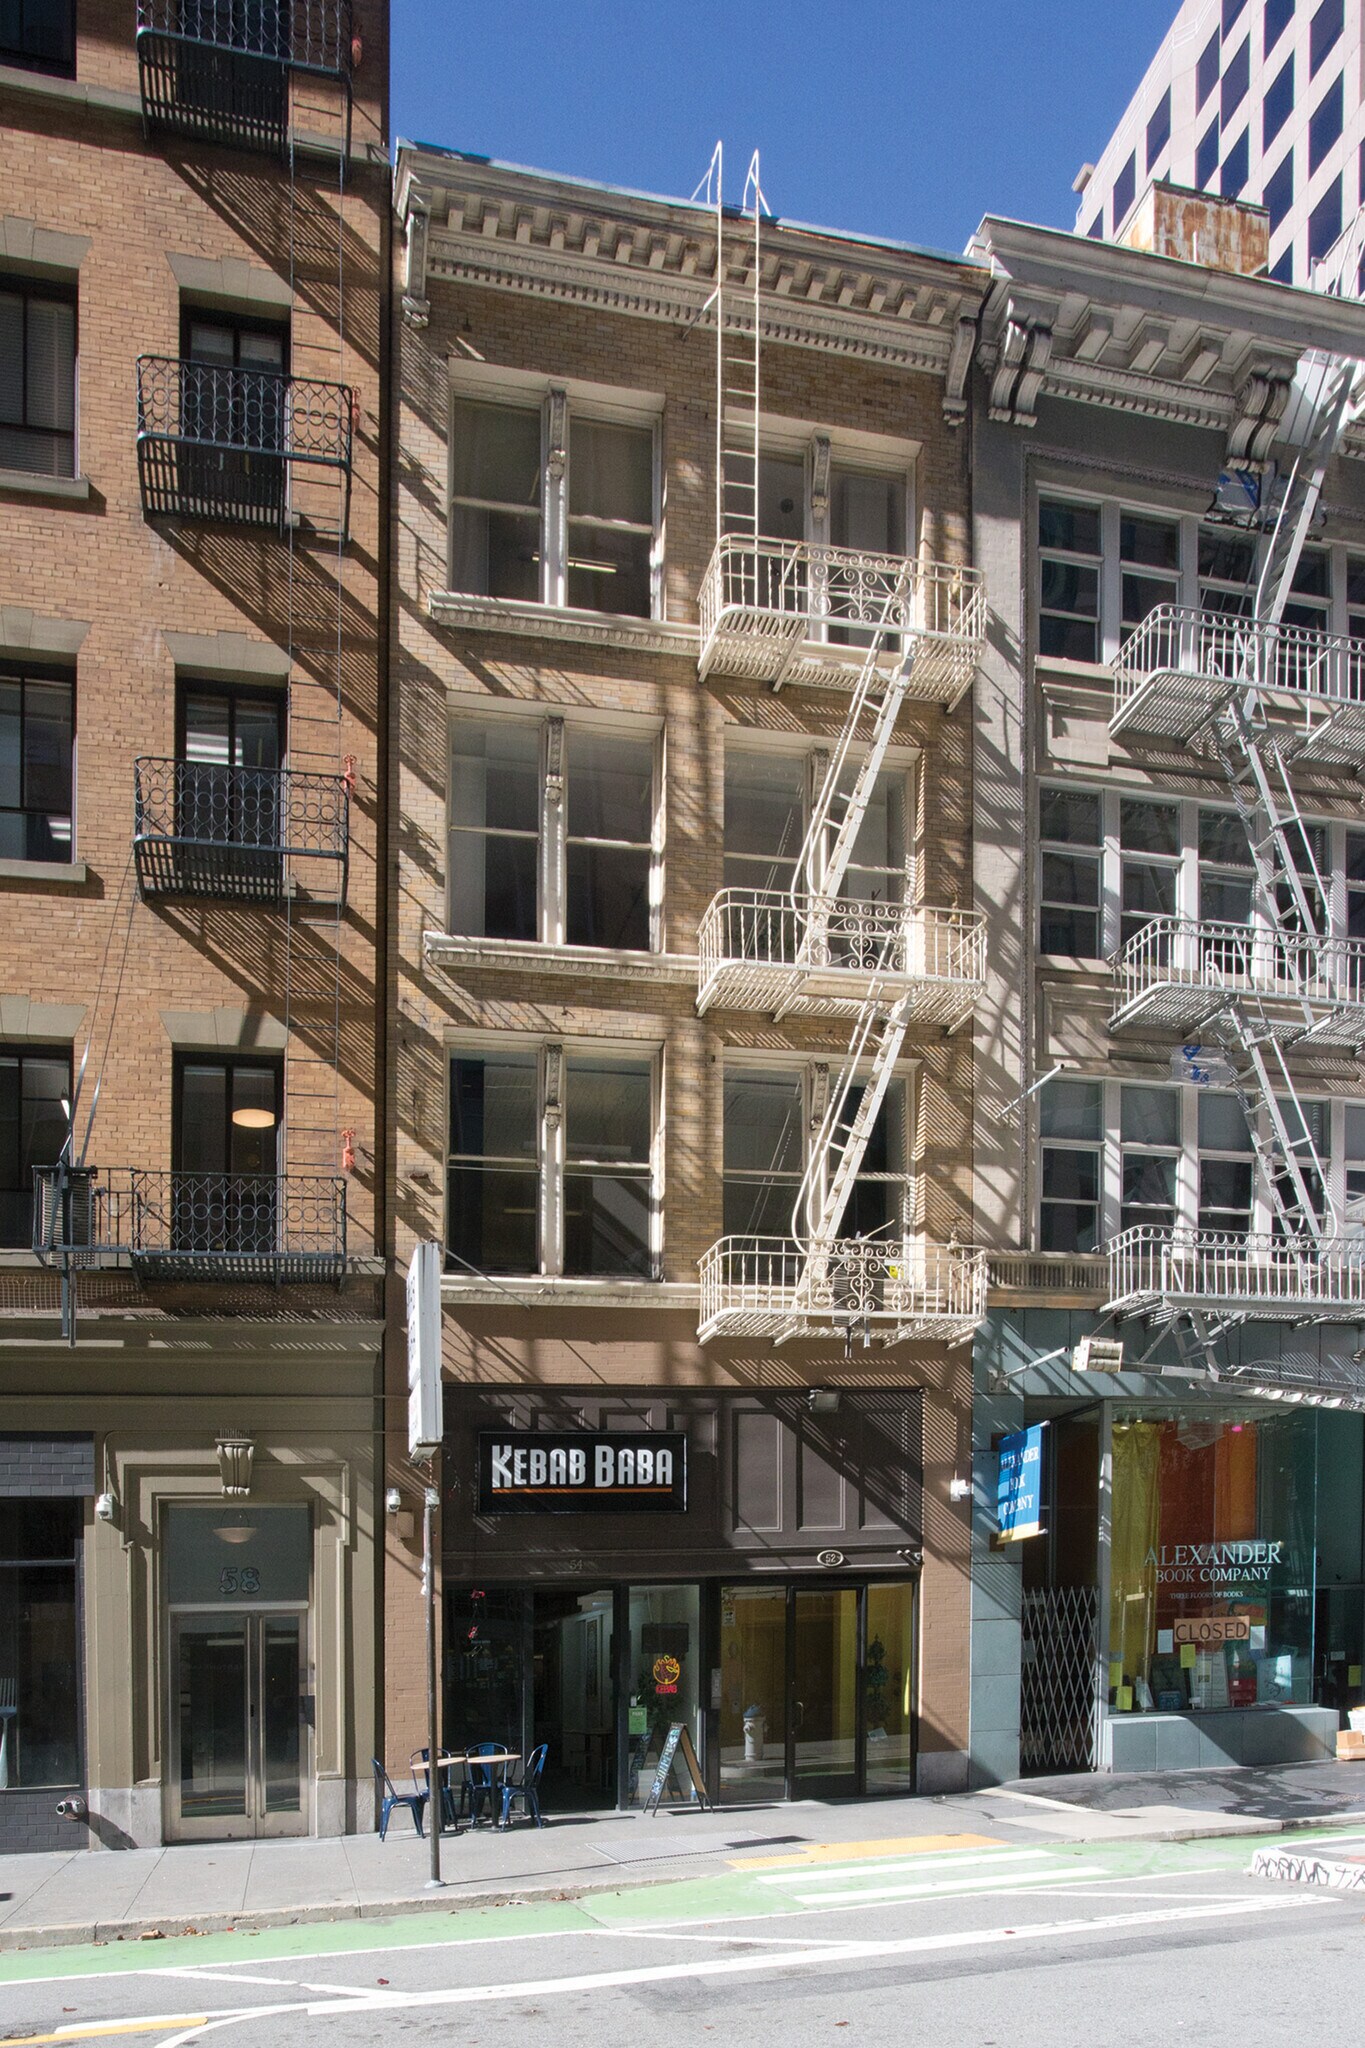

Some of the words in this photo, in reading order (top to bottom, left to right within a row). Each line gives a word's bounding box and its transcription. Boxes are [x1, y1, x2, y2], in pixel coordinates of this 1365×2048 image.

[492, 1445, 586, 1488] KEBAB
[594, 1445, 673, 1488] BABA
[825, 1553, 836, 1563] 52
[1144, 1543, 1282, 1567] ALEXANDER
[569, 1559, 583, 1570] 54
[219, 1566, 261, 1595] 58
[1156, 1569, 1195, 1583] BOOK
[1200, 1567, 1272, 1581] COMPANY
[1214, 1591, 1222, 1599] OF
[1175, 1622, 1248, 1641] CLOSED
[655, 1684, 678, 1694] KEBAB
